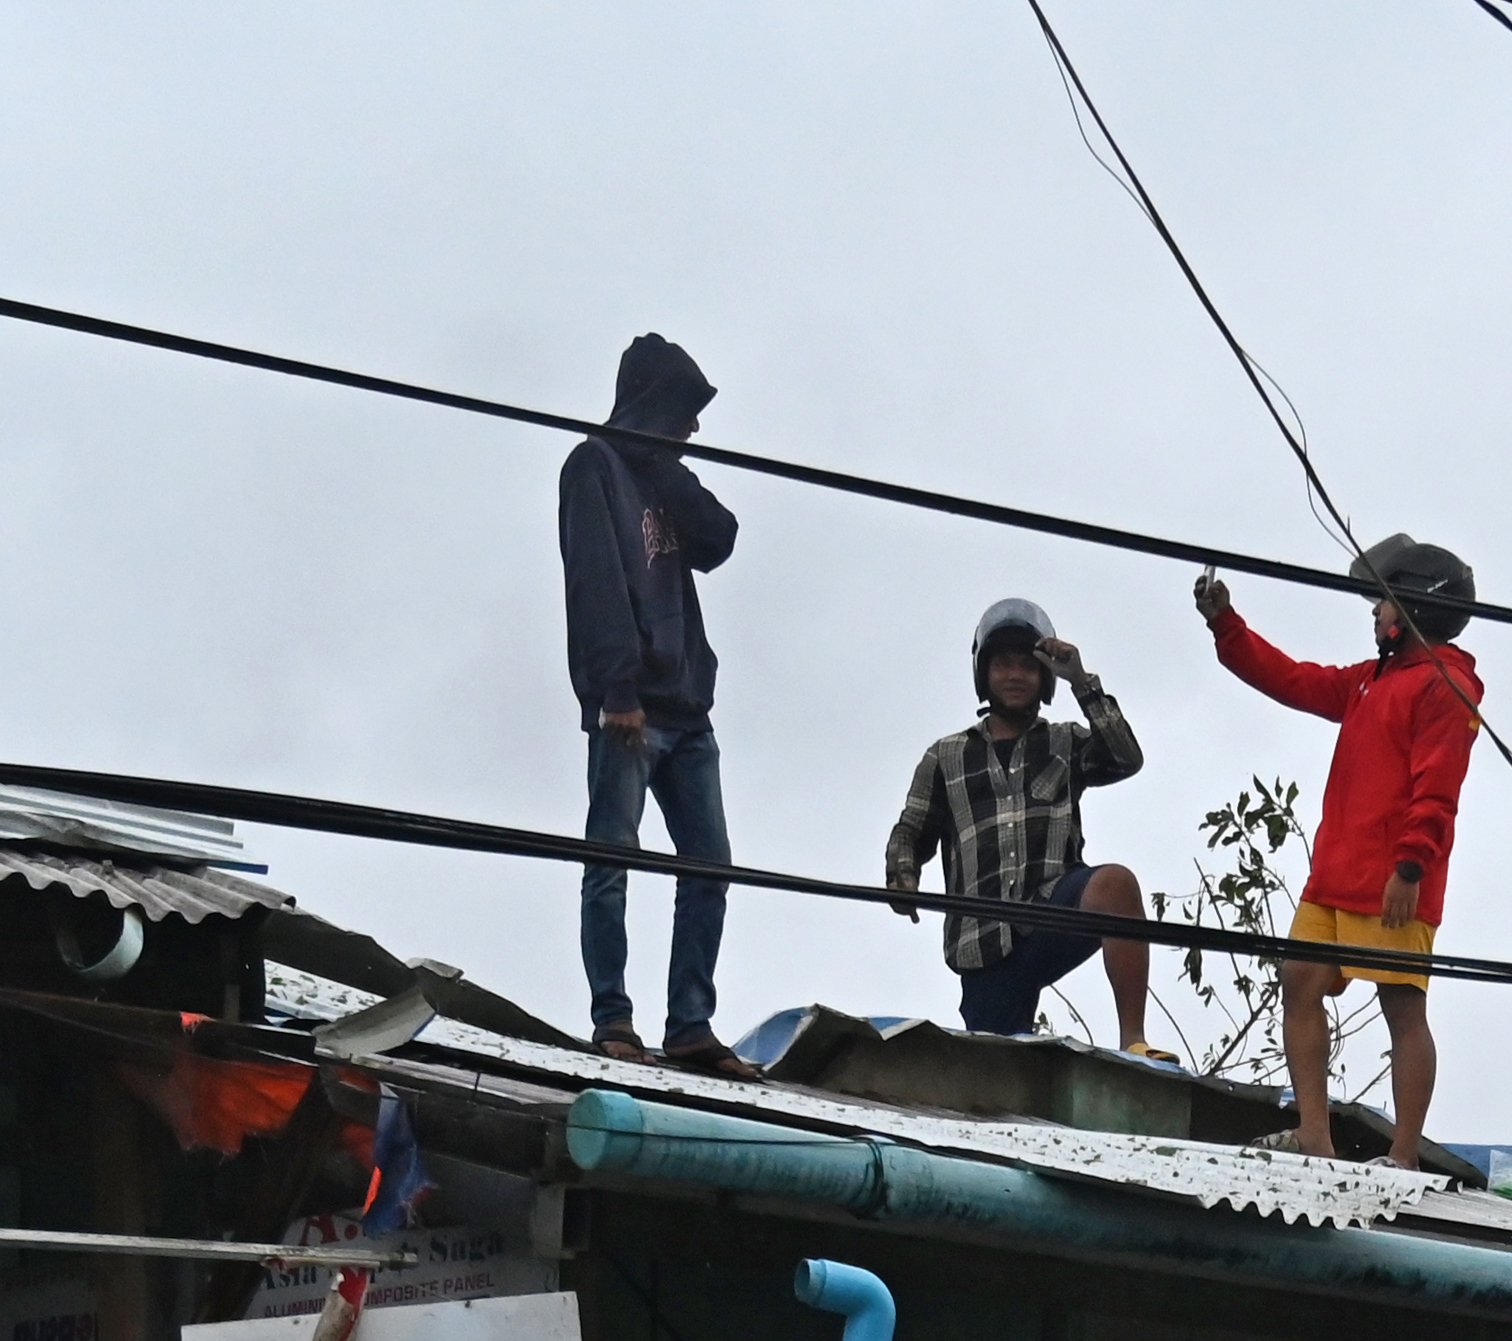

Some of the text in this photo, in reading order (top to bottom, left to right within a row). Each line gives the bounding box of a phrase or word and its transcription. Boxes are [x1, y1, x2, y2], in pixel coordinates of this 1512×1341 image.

[265, 1273, 496, 1318] ALUMINI MPOSITE PANEL
